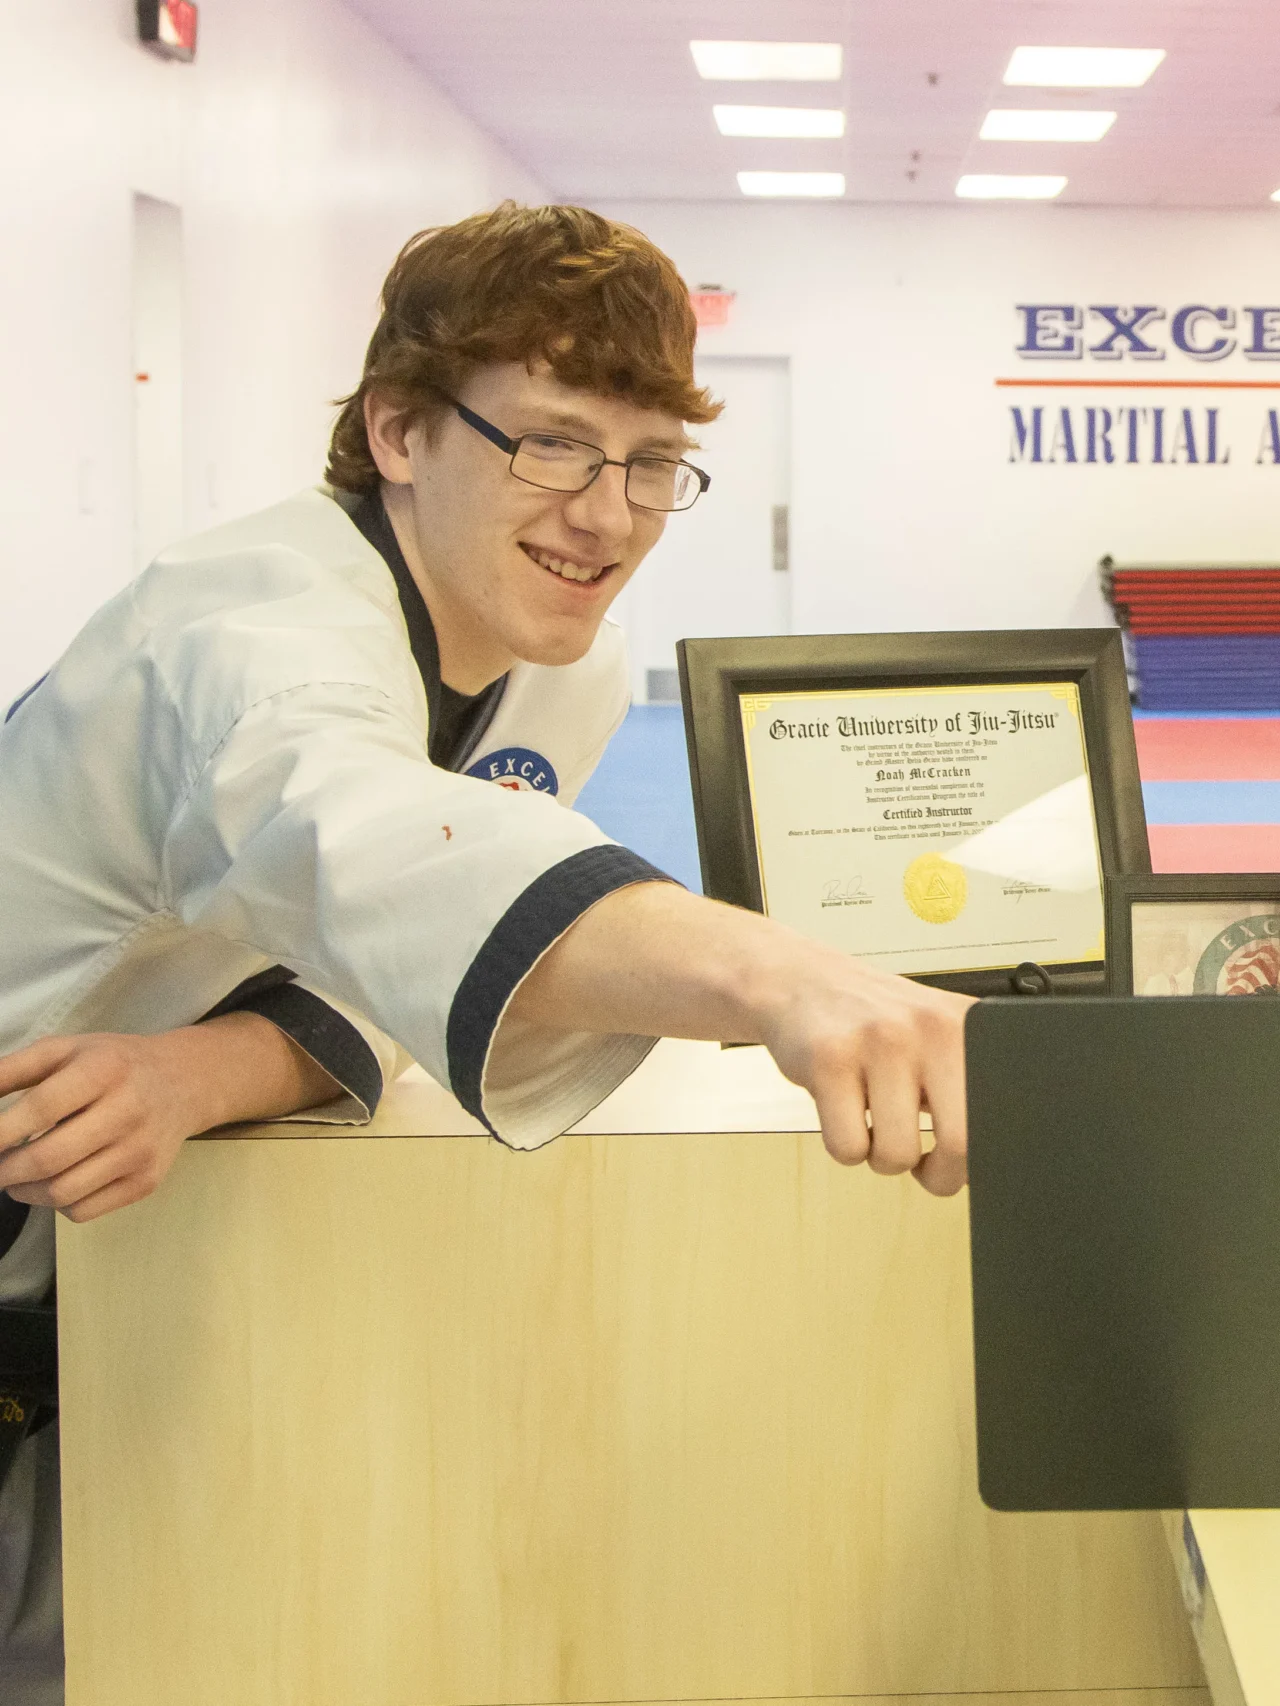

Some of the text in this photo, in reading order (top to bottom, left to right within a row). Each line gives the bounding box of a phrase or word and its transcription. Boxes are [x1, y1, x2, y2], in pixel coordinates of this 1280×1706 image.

[1008, 406, 1230, 465] MARTIAL
[769, 717, 829, 741] Gracie
[837, 715, 938, 739] University
[945, 712, 962, 734] of
[875, 766, 971, 782] Noah McCracken
[883, 806, 972, 820] Certified Instructor
